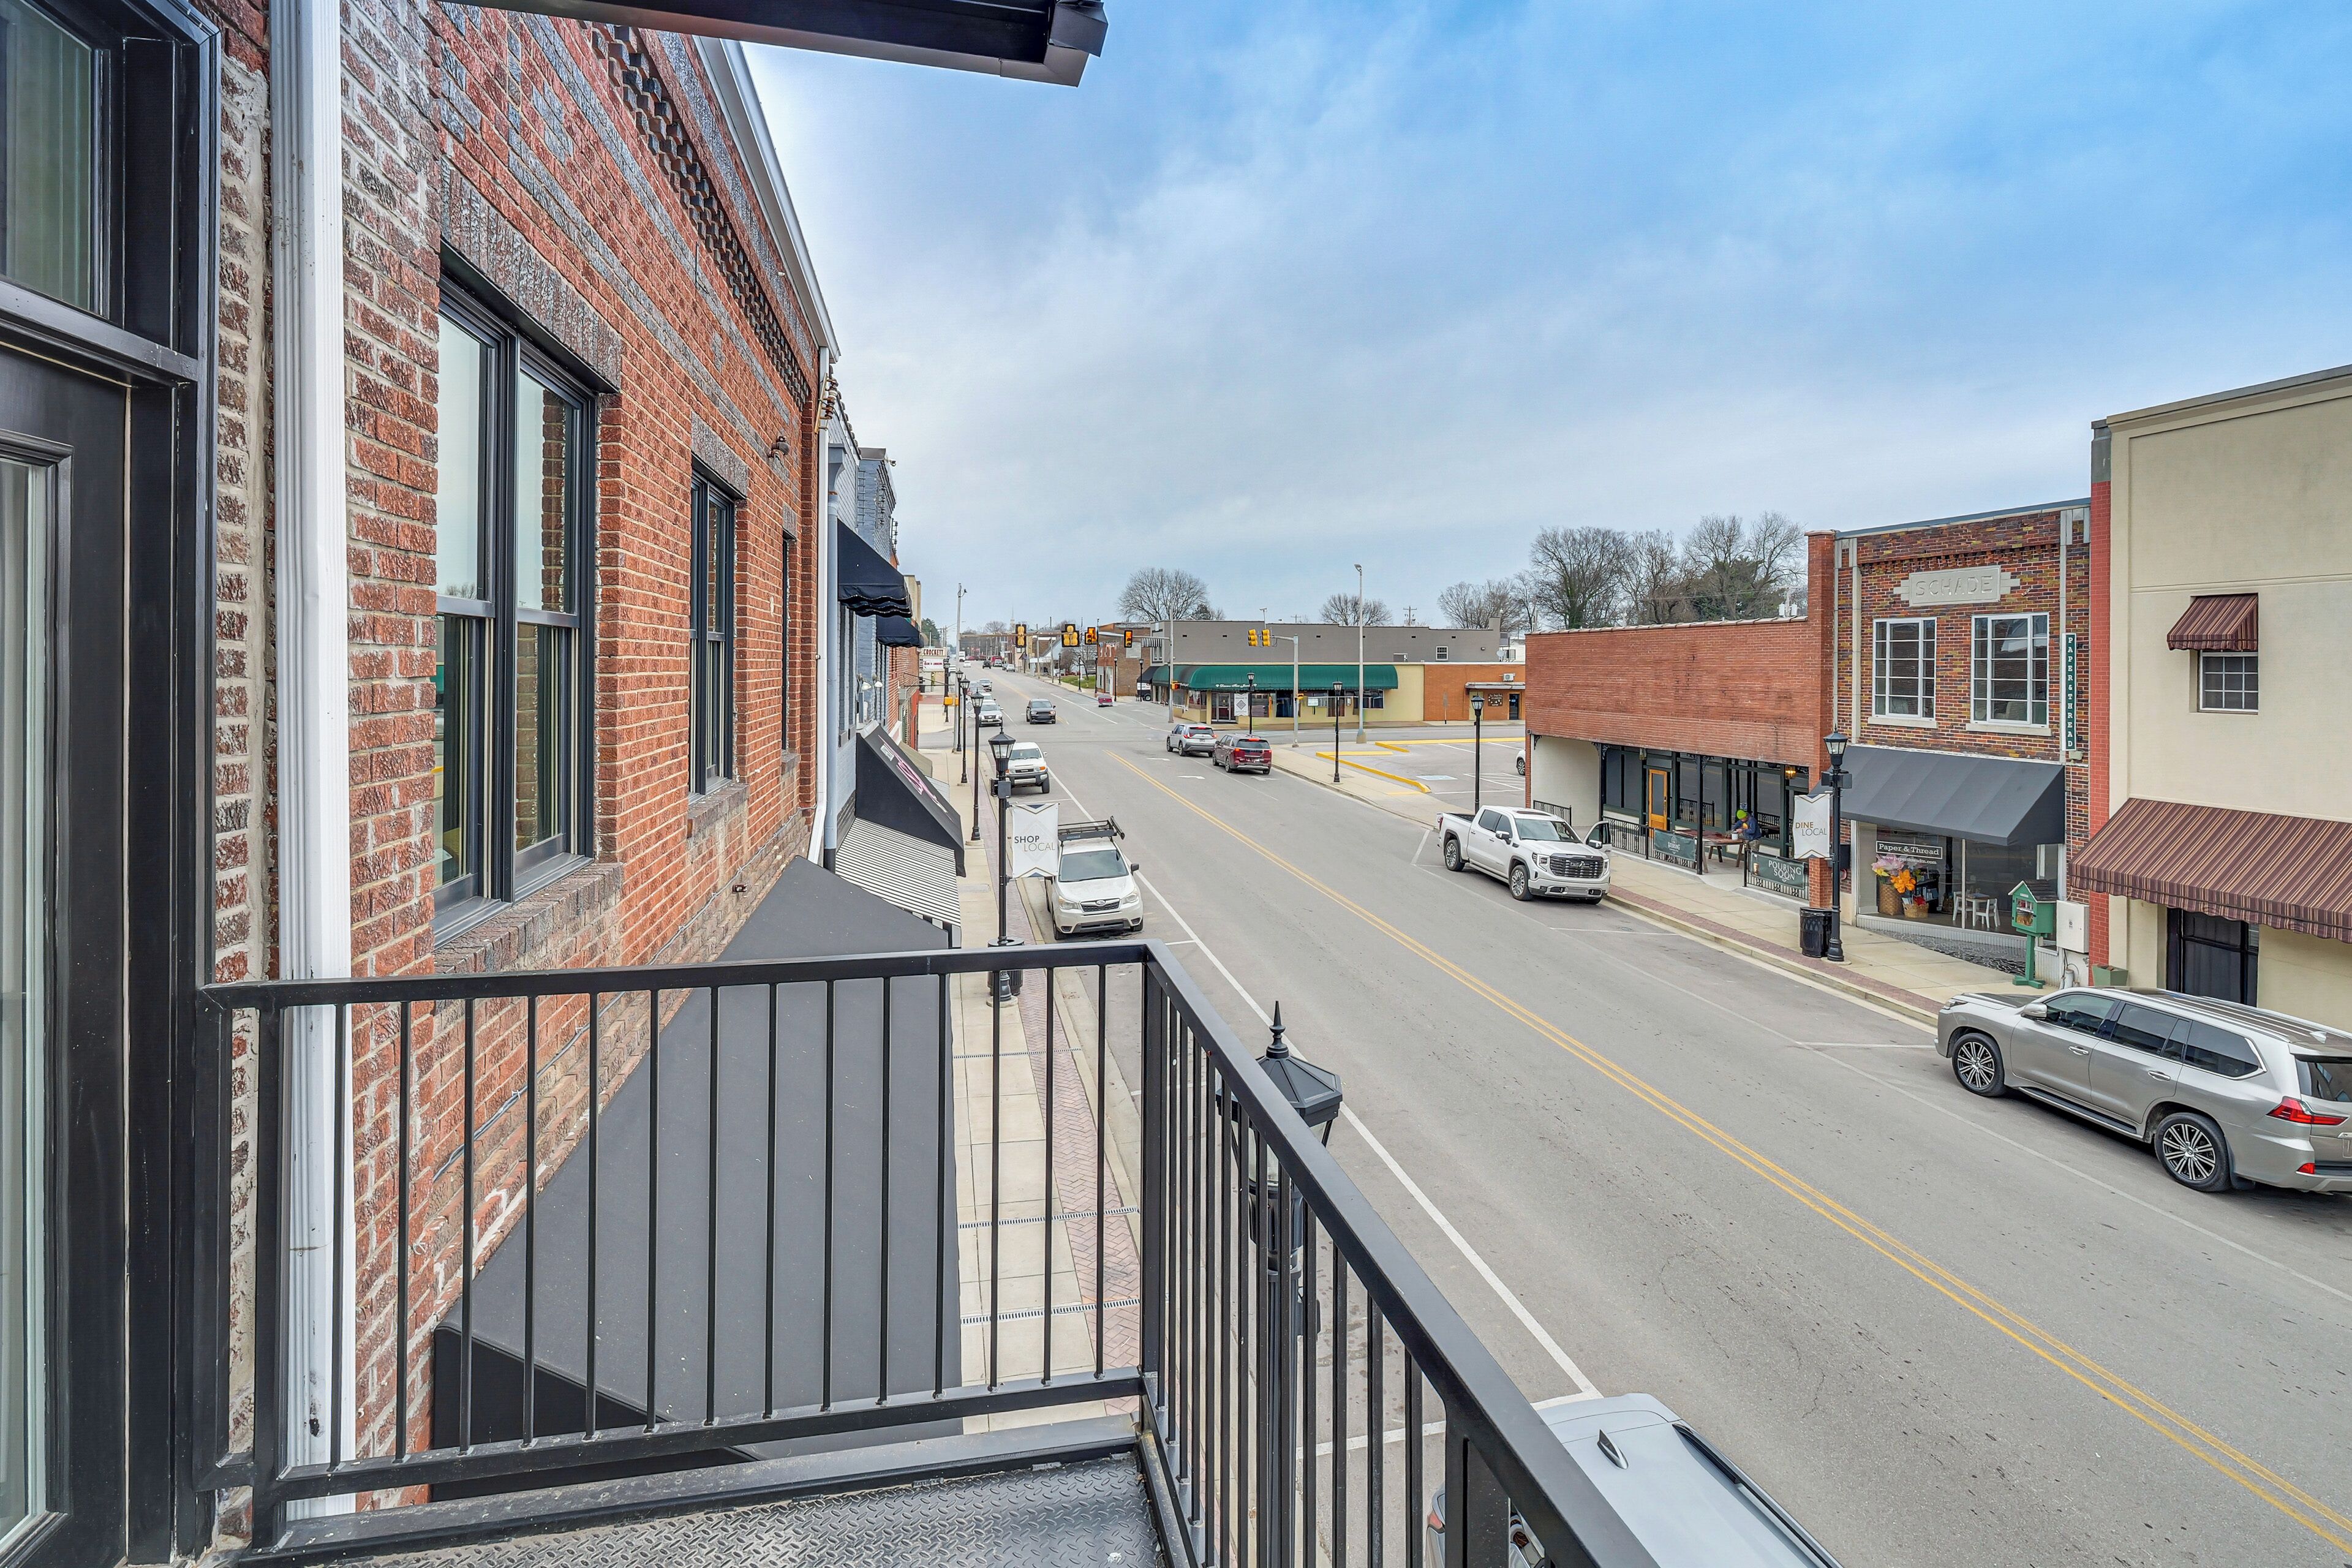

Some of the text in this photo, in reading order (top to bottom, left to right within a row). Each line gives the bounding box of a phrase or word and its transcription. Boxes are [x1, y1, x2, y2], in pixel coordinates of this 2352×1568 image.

[1916, 576, 1993, 597] SCHADE
[1802, 827, 1827, 836] LOCAL
[1024, 842, 1055, 851] LOCAL
[1879, 843, 1902, 852] Paper
[1911, 846, 1939, 855] Thread
[1768, 860, 1801, 875] POURING
[1774, 869, 1795, 881] SOON
